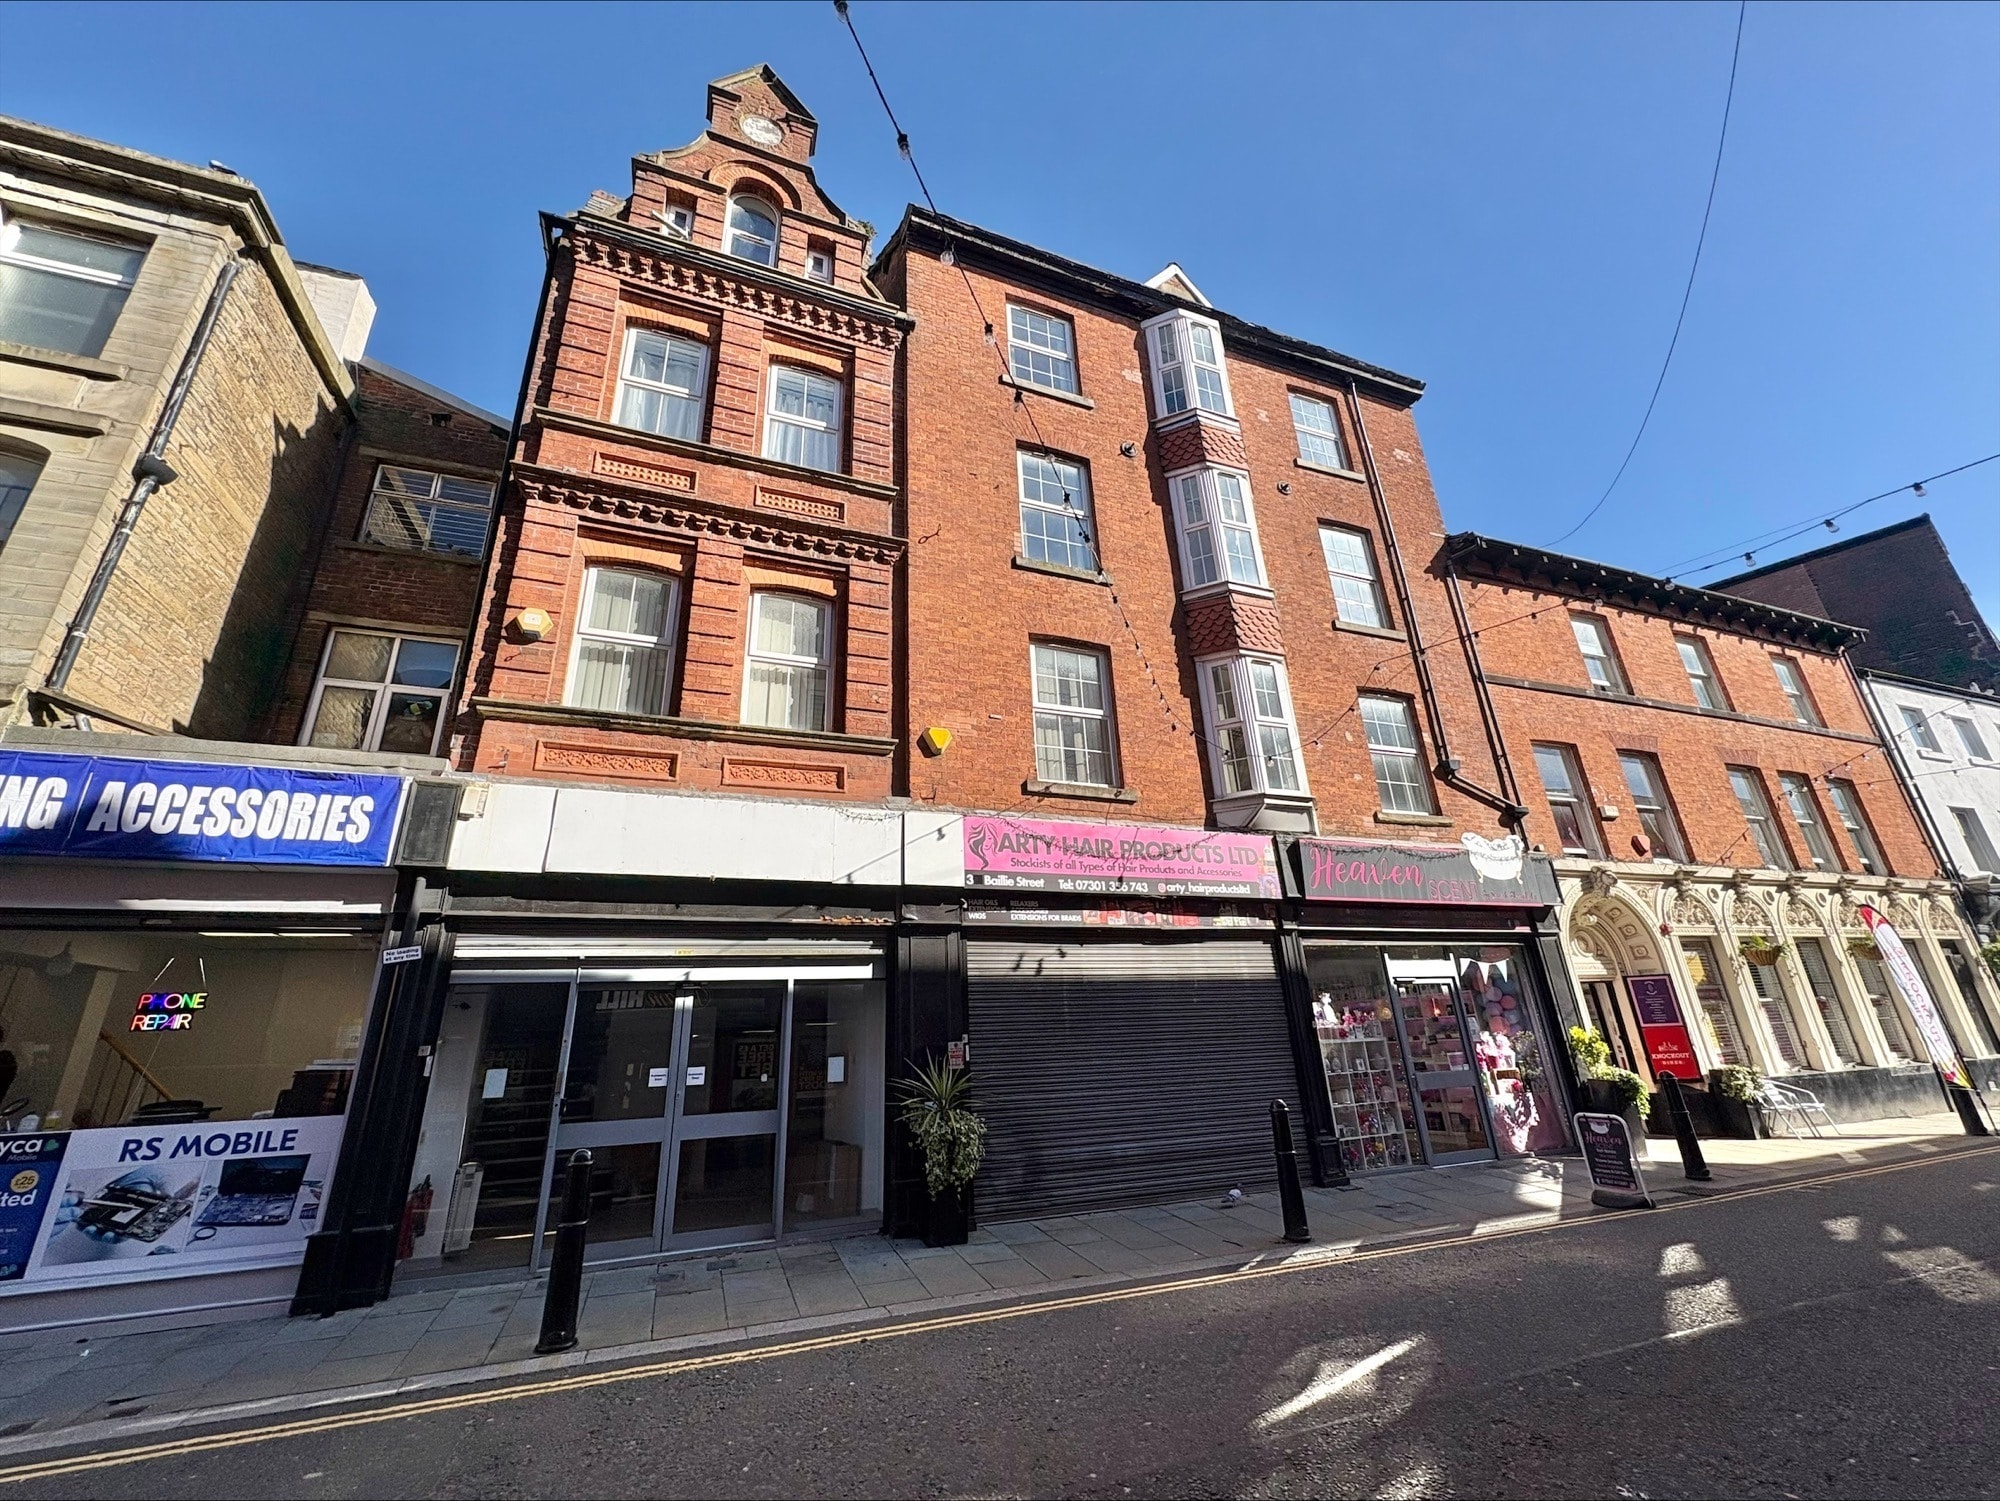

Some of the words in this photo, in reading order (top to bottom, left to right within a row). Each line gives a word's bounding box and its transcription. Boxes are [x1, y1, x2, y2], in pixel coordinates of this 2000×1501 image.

[86, 781, 375, 844] ACCESSORIES
[997, 832, 1053, 856] ARTY
[1061, 836, 1115, 859] HAIR
[1119, 839, 1225, 865] PRODUCTS
[1228, 846, 1259, 866] LTD
[1010, 857, 1051, 869] Stockists
[1053, 860, 1064, 869] of
[1065, 860, 1076, 870] all
[1078, 861, 1104, 873] Types
[1106, 862, 1117, 871] of
[1118, 862, 1137, 872] Hair
[1139, 864, 1175, 875] Products
[1177, 865, 1195, 875] and
[1197, 867, 1242, 877] Accessories
[1309, 847, 1423, 890] Heaven
[966, 874, 974, 885] 3
[984, 874, 1015, 887] Baillie
[1016, 876, 1045, 888] Street
[1058, 879, 1074, 890] Tel:
[1076, 880, 1106, 891] 07301
[1130, 882, 1149, 893] 743
[1428, 879, 1477, 899] SCENT
[968, 912, 987, 920] WIGS
[137, 992, 208, 1010] PHONE
[130, 1013, 192, 1031] REPAIR
[1651, 1052, 1690, 1060] KNOCKOUT
[118, 1137, 164, 1163] RS
[169, 1128, 299, 1160] MOBILE
[7, 1154, 38, 1163] Mobile
[14, 1175, 36, 1186] £25
